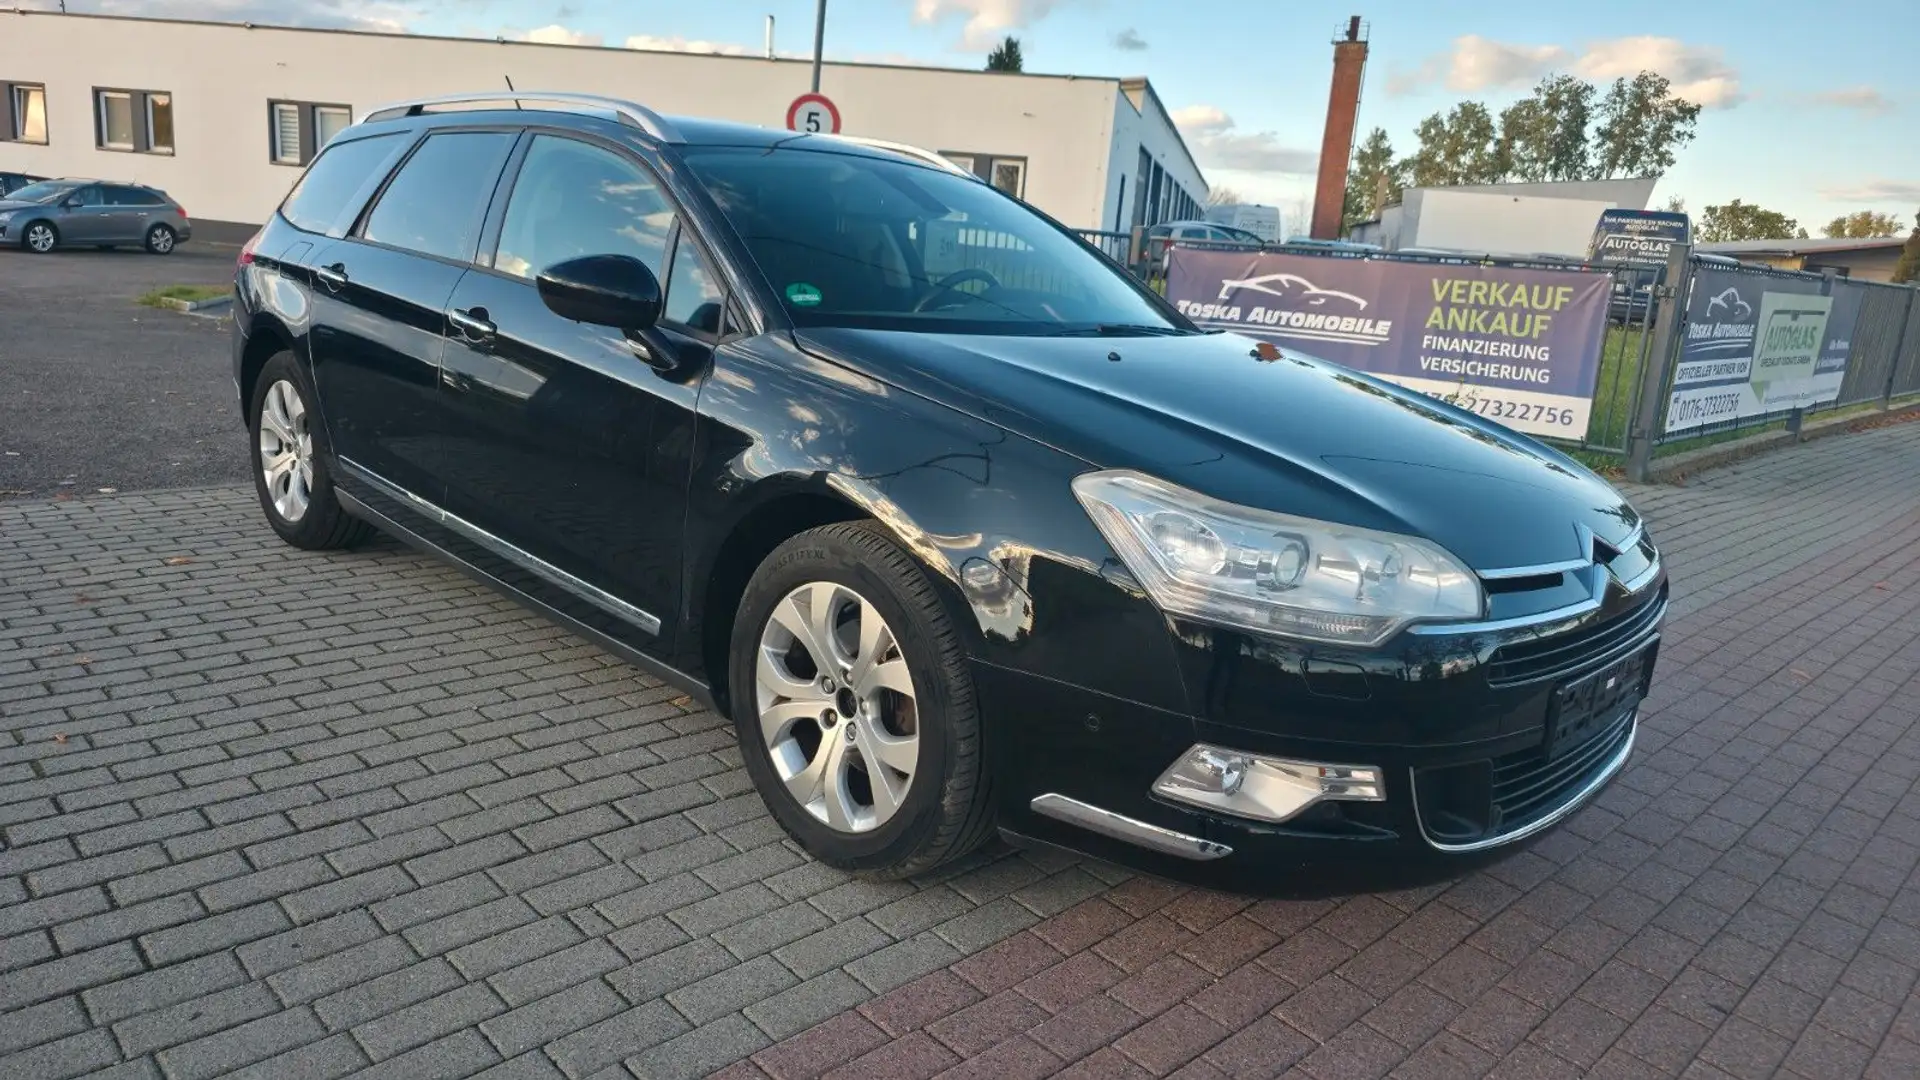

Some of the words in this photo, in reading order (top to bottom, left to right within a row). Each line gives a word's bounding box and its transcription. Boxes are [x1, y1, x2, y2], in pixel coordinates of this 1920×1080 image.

[806, 111, 820, 133] 5
[1605, 239, 1671, 252] AUTOGLAS
[1432, 278, 1574, 311] VERKAUF
[1177, 300, 1241, 321] TOSKA
[1246, 306, 1392, 335] AUTOMOBILE
[1425, 306, 1552, 339] ANKAUF
[1422, 335, 1550, 361] FINANZIERUNG
[1765, 325, 1818, 353] AUTOGLAS
[1420, 355, 1550, 384] VERSICHERUNG
